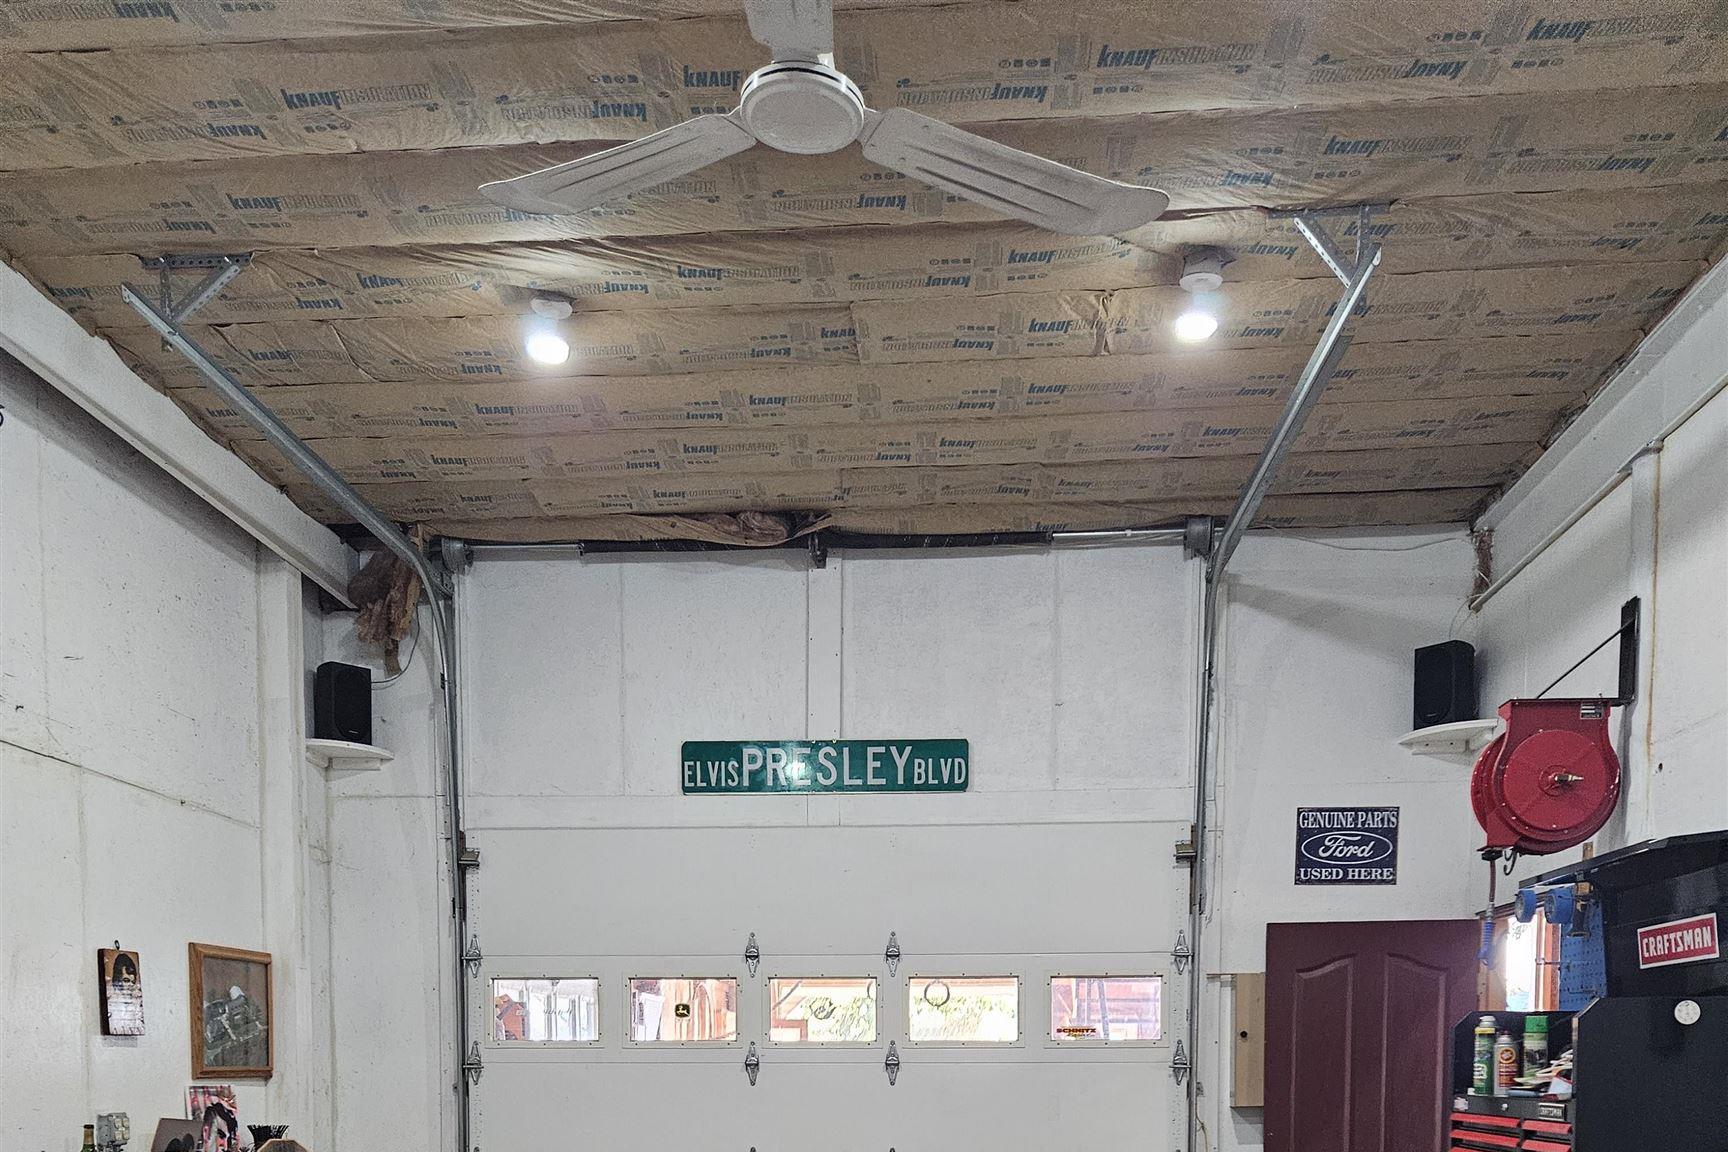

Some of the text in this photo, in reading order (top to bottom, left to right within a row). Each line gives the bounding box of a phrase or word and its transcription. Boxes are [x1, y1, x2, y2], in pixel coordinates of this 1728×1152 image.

[1527, 18, 1595, 42] KNAUF
[1096, 44, 1159, 69] KNAUF
[1407, 59, 1468, 80] KNAUF
[683, 65, 741, 92] KNAUF
[991, 83, 1048, 103] KNAUF
[281, 89, 341, 111] KNAUF
[592, 101, 647, 122] KNAUF
[208, 122, 267, 140] KNAUF
[1324, 135, 1382, 157] KNAUF
[1599, 155, 1657, 174] KNAUF
[1222, 169, 1273, 188] KNAUF
[226, 192, 282, 212] KNAUF
[857, 193, 907, 211] KNAUF
[163, 219, 217, 234] KNAUF
[1007, 250, 1055, 264] KNAUF
[1247, 242, 1297, 259] KNAUF
[677, 265, 723, 281] KNAUF
[357, 273, 402, 290] KNAUF
[603, 281, 650, 294] KNAUF
[925, 275, 971, 288] KNAUF
[297, 298, 343, 310] KNAUF
[1028, 319, 1072, 333] KNAUF
[1241, 326, 1284, 338] KNAUF
[820, 327, 856, 339] KNAU
[952, 338, 994, 350] KNAUF
[749, 347, 791, 358] KNAUF
[461, 363, 503, 375] KNAUF
[1028, 383, 1068, 395] KNAUF
[1236, 386, 1277, 397] KNAUF
[749, 394, 787, 406] KNAUF
[956, 400, 995, 411] KNAUF
[475, 404, 515, 416] KNAUF
[685, 411, 723, 421] KNAUF
[418, 418, 457, 429] KNAUF
[1202, 426, 1241, 437] KNAUF
[683, 443, 718, 455] KNAUF
[939, 437, 977, 448] KNAUF
[1132, 443, 1170, 452] KNAUF
[431, 454, 468, 466] KNAUF
[875, 451, 911, 462] KNAUF
[625, 460, 661, 470] KNAUF
[381, 469, 416, 479] KNAUF
[653, 489, 687, 499] KNAUF
[683, 745, 968, 788] ELVIS PRESLEY BLVD
[1299, 811, 1398, 829] GENUINE PARTS
[1318, 834, 1376, 857] Ford
[1299, 867, 1394, 880] USED HERE
[1642, 925, 1713, 958] CRAFTSMAN
